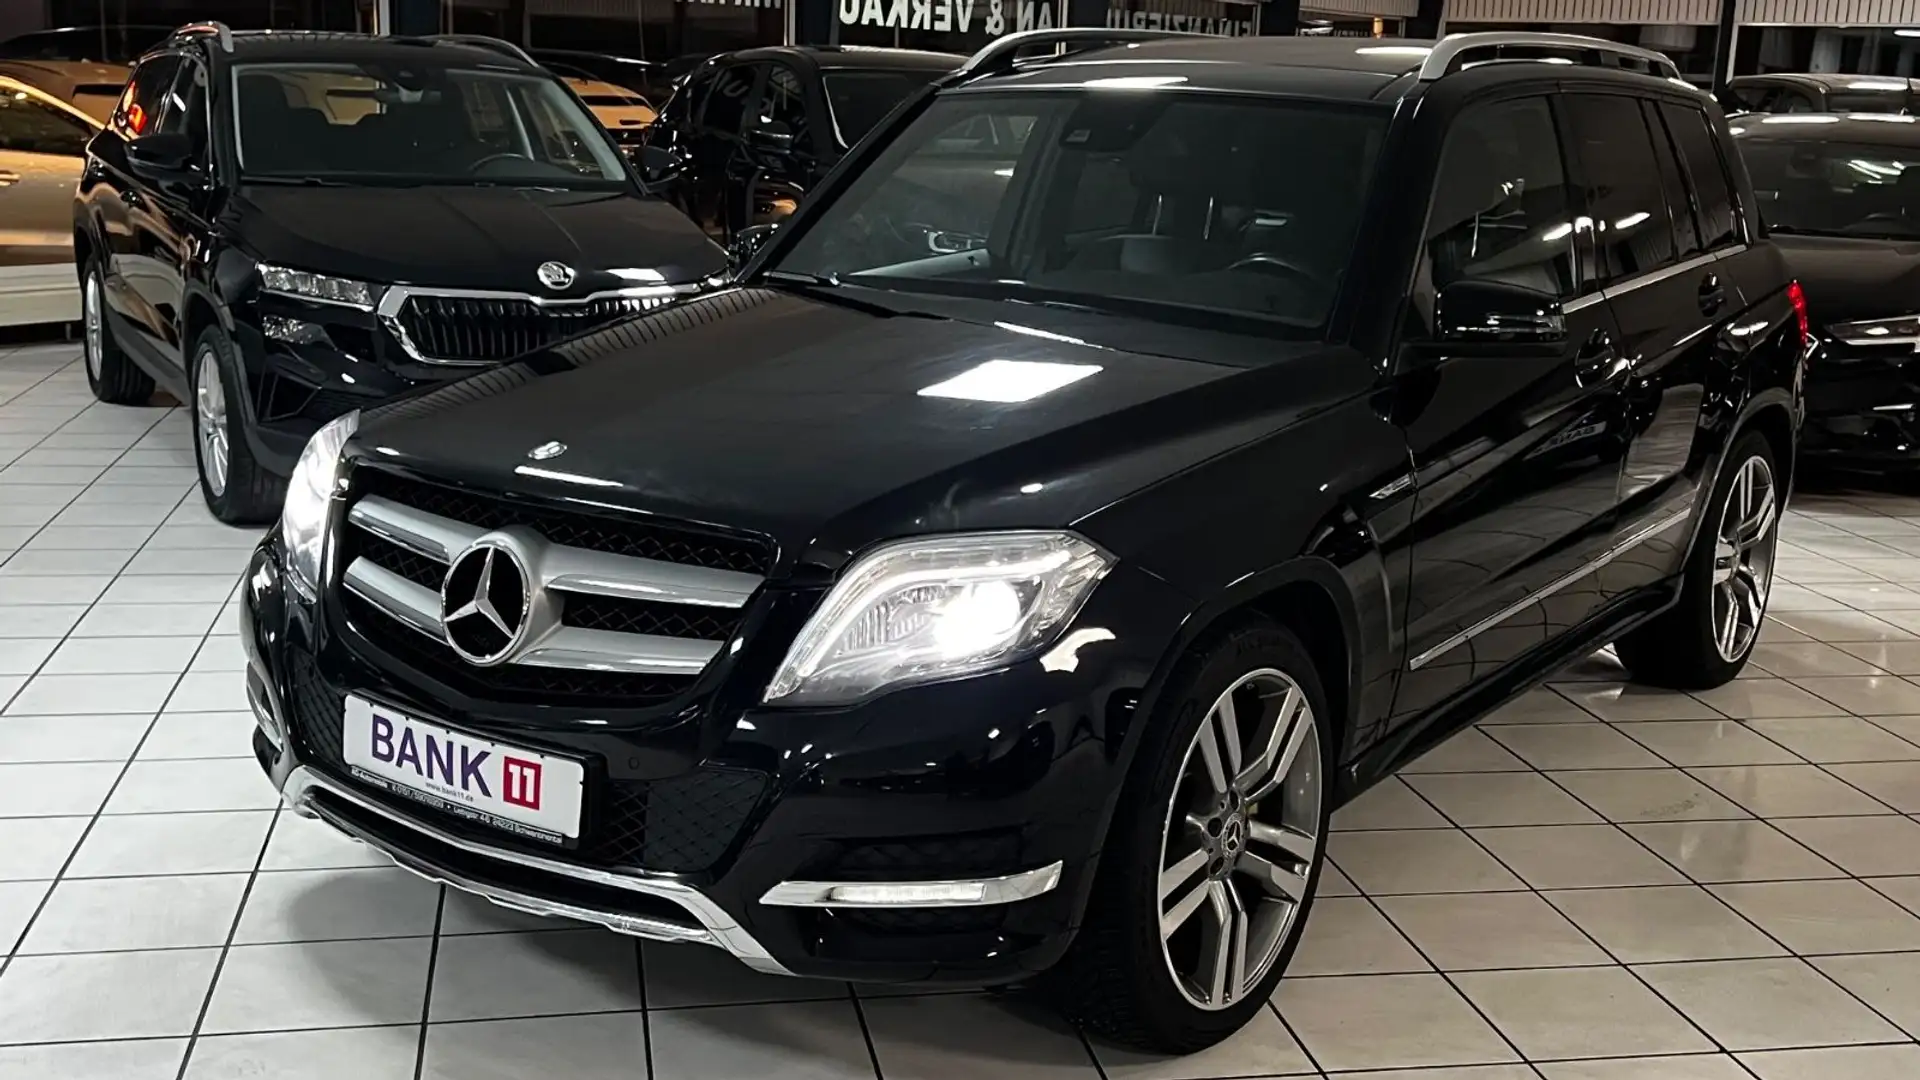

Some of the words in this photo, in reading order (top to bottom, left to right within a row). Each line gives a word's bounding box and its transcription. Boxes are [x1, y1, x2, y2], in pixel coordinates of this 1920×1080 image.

[371, 713, 493, 798] BANK
[506, 763, 537, 805] 11
[425, 781, 475, 803] www.bank11.de
